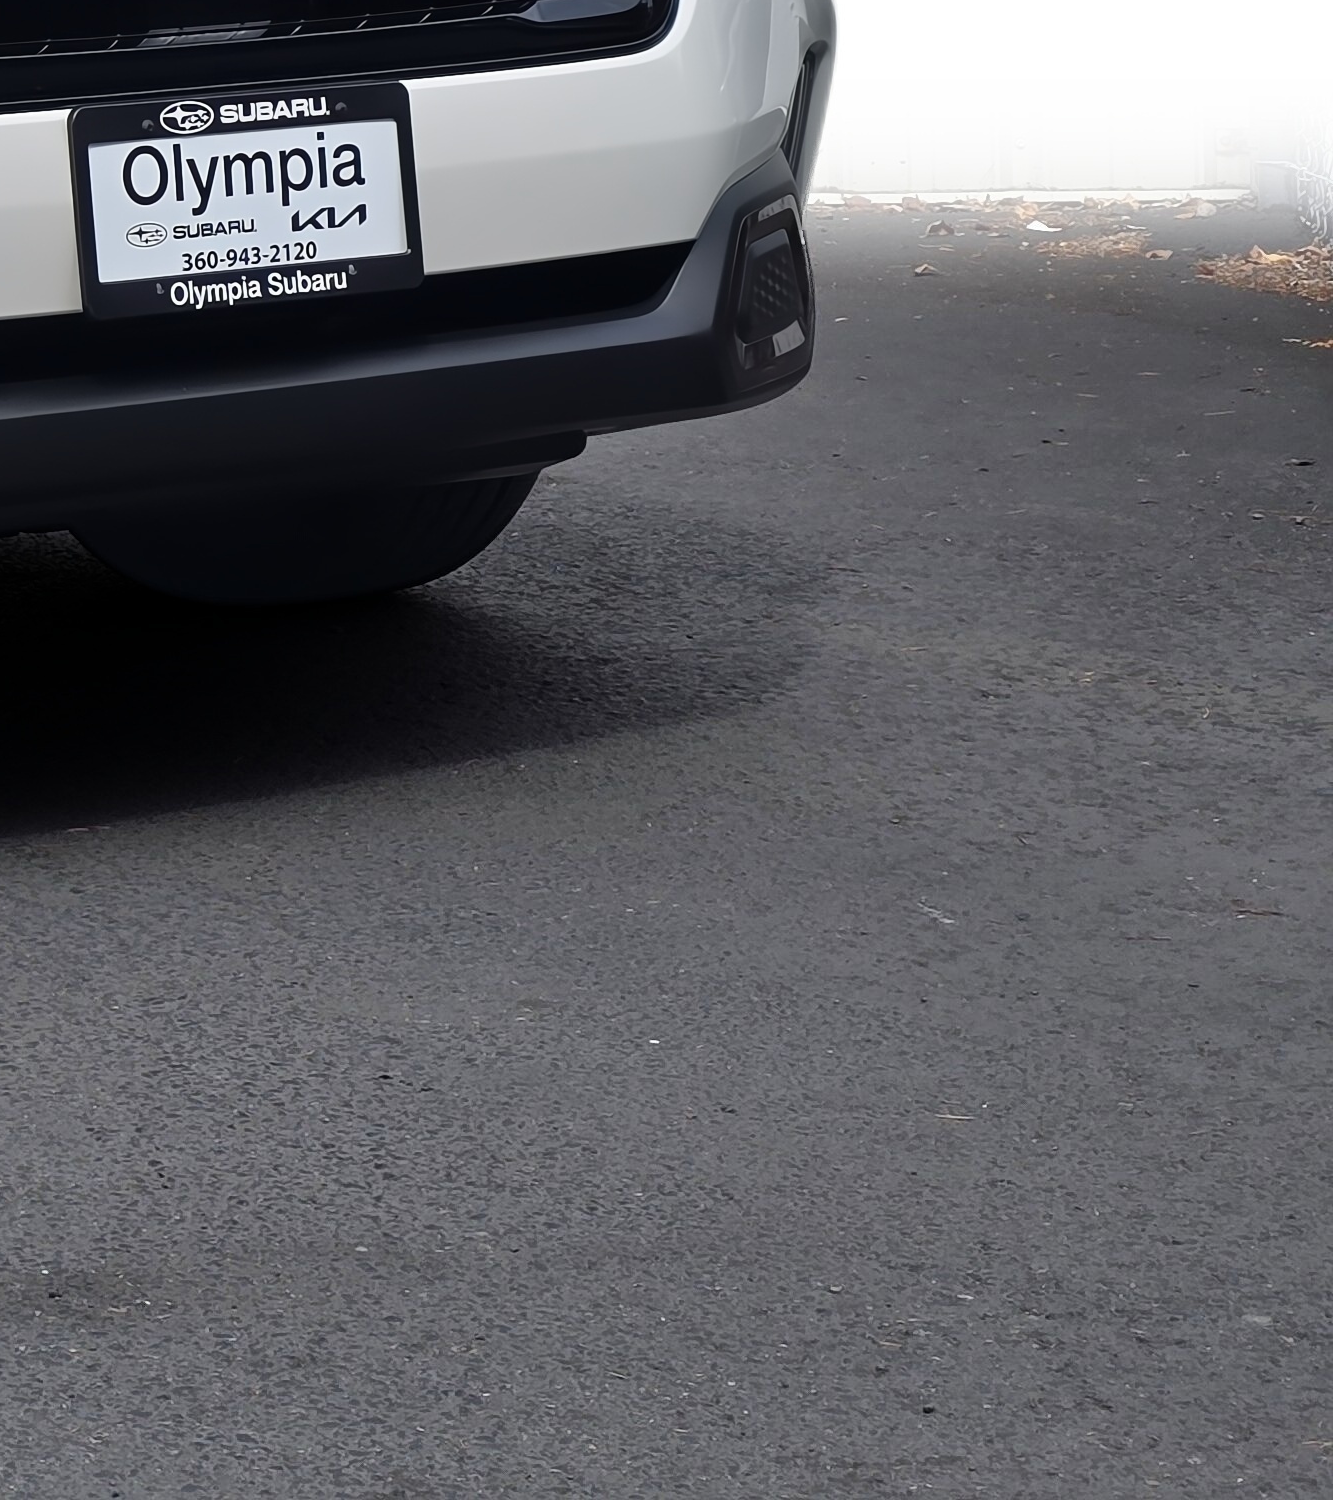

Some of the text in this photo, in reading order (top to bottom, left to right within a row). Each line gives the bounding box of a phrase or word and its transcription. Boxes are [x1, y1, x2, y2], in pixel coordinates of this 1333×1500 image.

[122, 131, 366, 216] Olympia
[181, 240, 318, 272] 360-943-2120
[170, 269, 348, 310] Olympia Subaru
